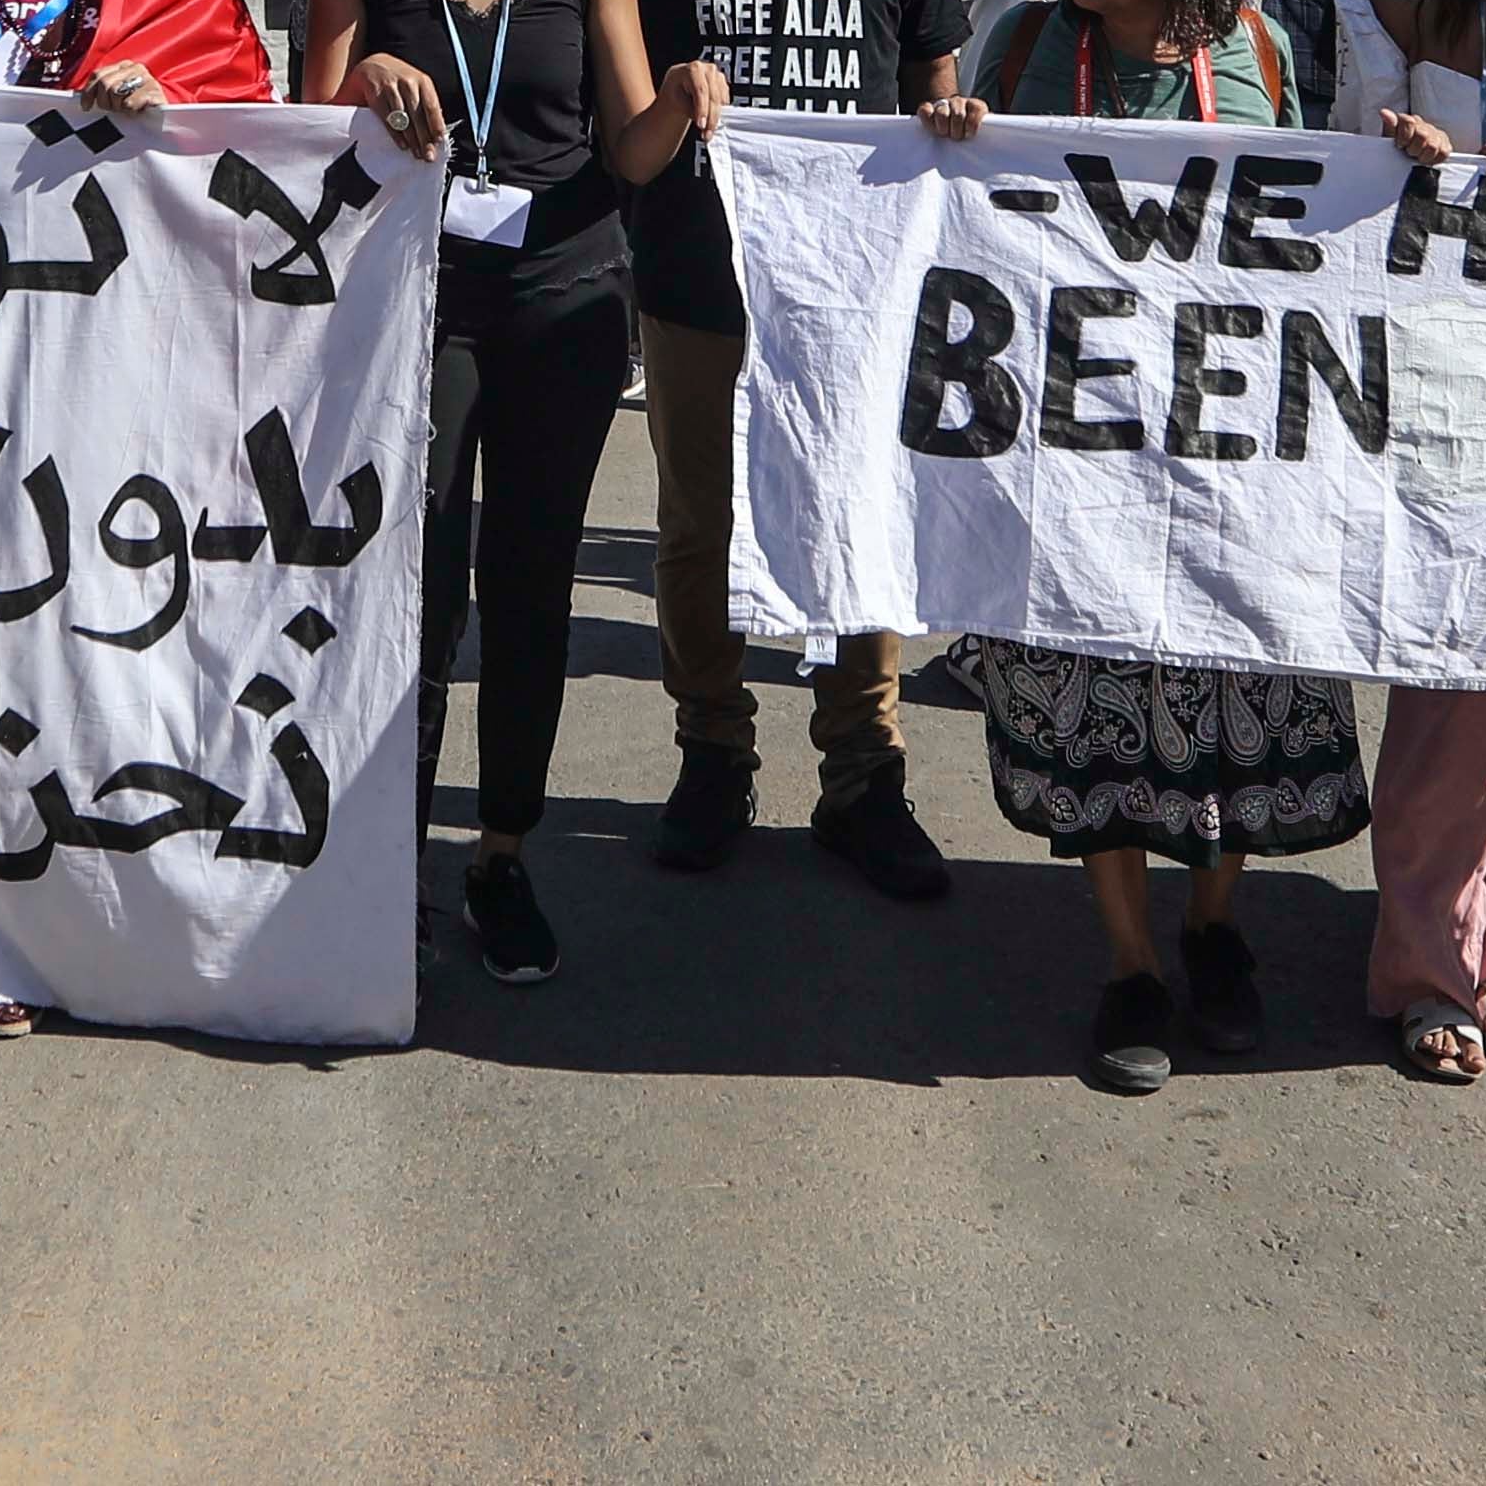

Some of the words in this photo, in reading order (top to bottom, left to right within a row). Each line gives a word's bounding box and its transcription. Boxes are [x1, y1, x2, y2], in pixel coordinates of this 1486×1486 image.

[781, 47, 862, 89] ALAA
[207, 140, 384, 306] لا
[899, 267, 1390, 462] BEEN
